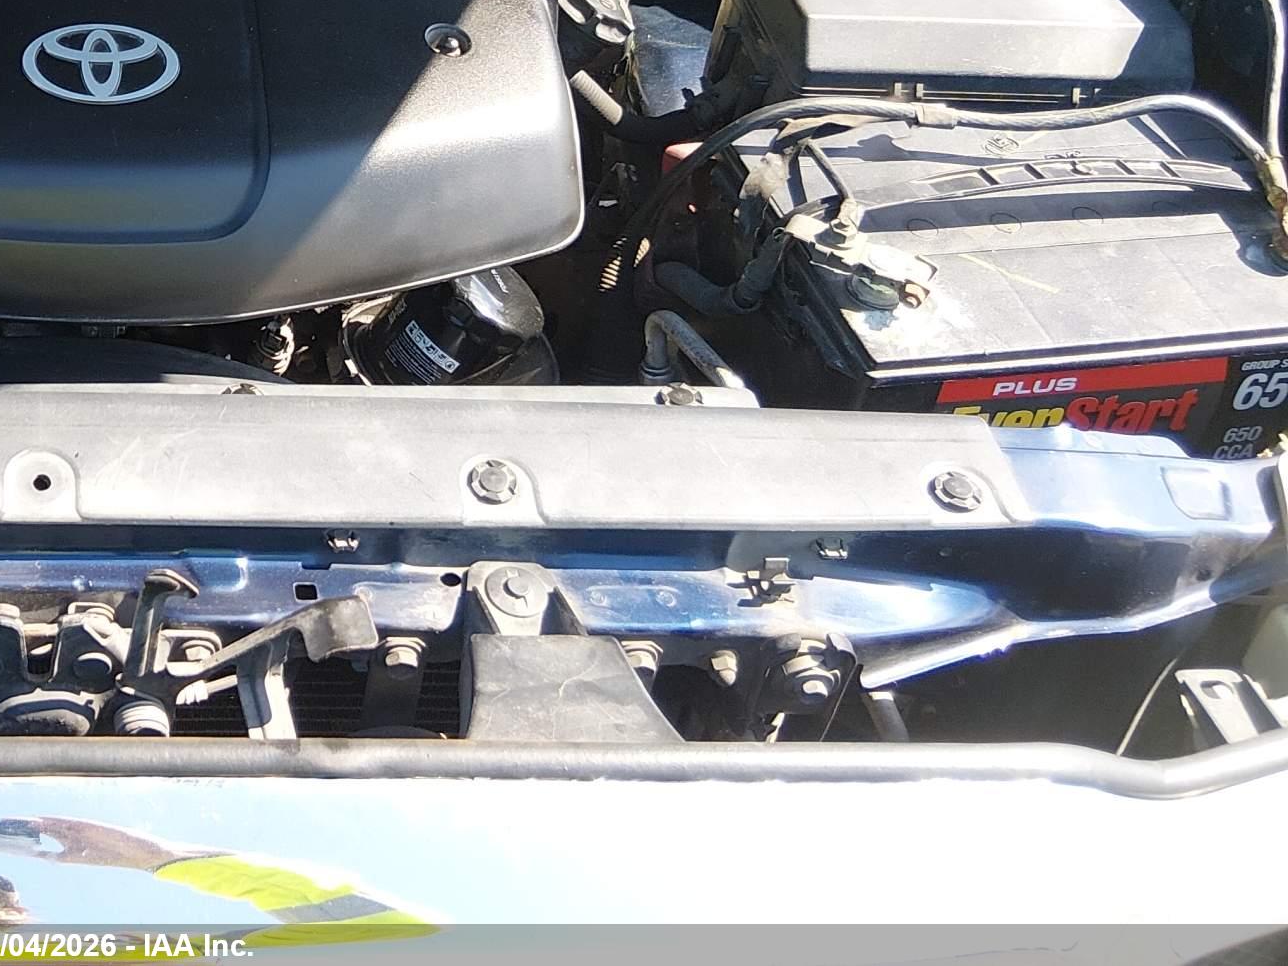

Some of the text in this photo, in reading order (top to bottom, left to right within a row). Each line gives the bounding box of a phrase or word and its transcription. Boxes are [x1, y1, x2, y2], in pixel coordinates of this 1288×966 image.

[1241, 359, 1281, 371] GROUP
[992, 377, 1078, 396] PLUS
[1232, 372, 1288, 411] 65
[953, 389, 1198, 434] erStart
[1223, 425, 1263, 443] 650
[1213, 443, 1254, 460] CCA
